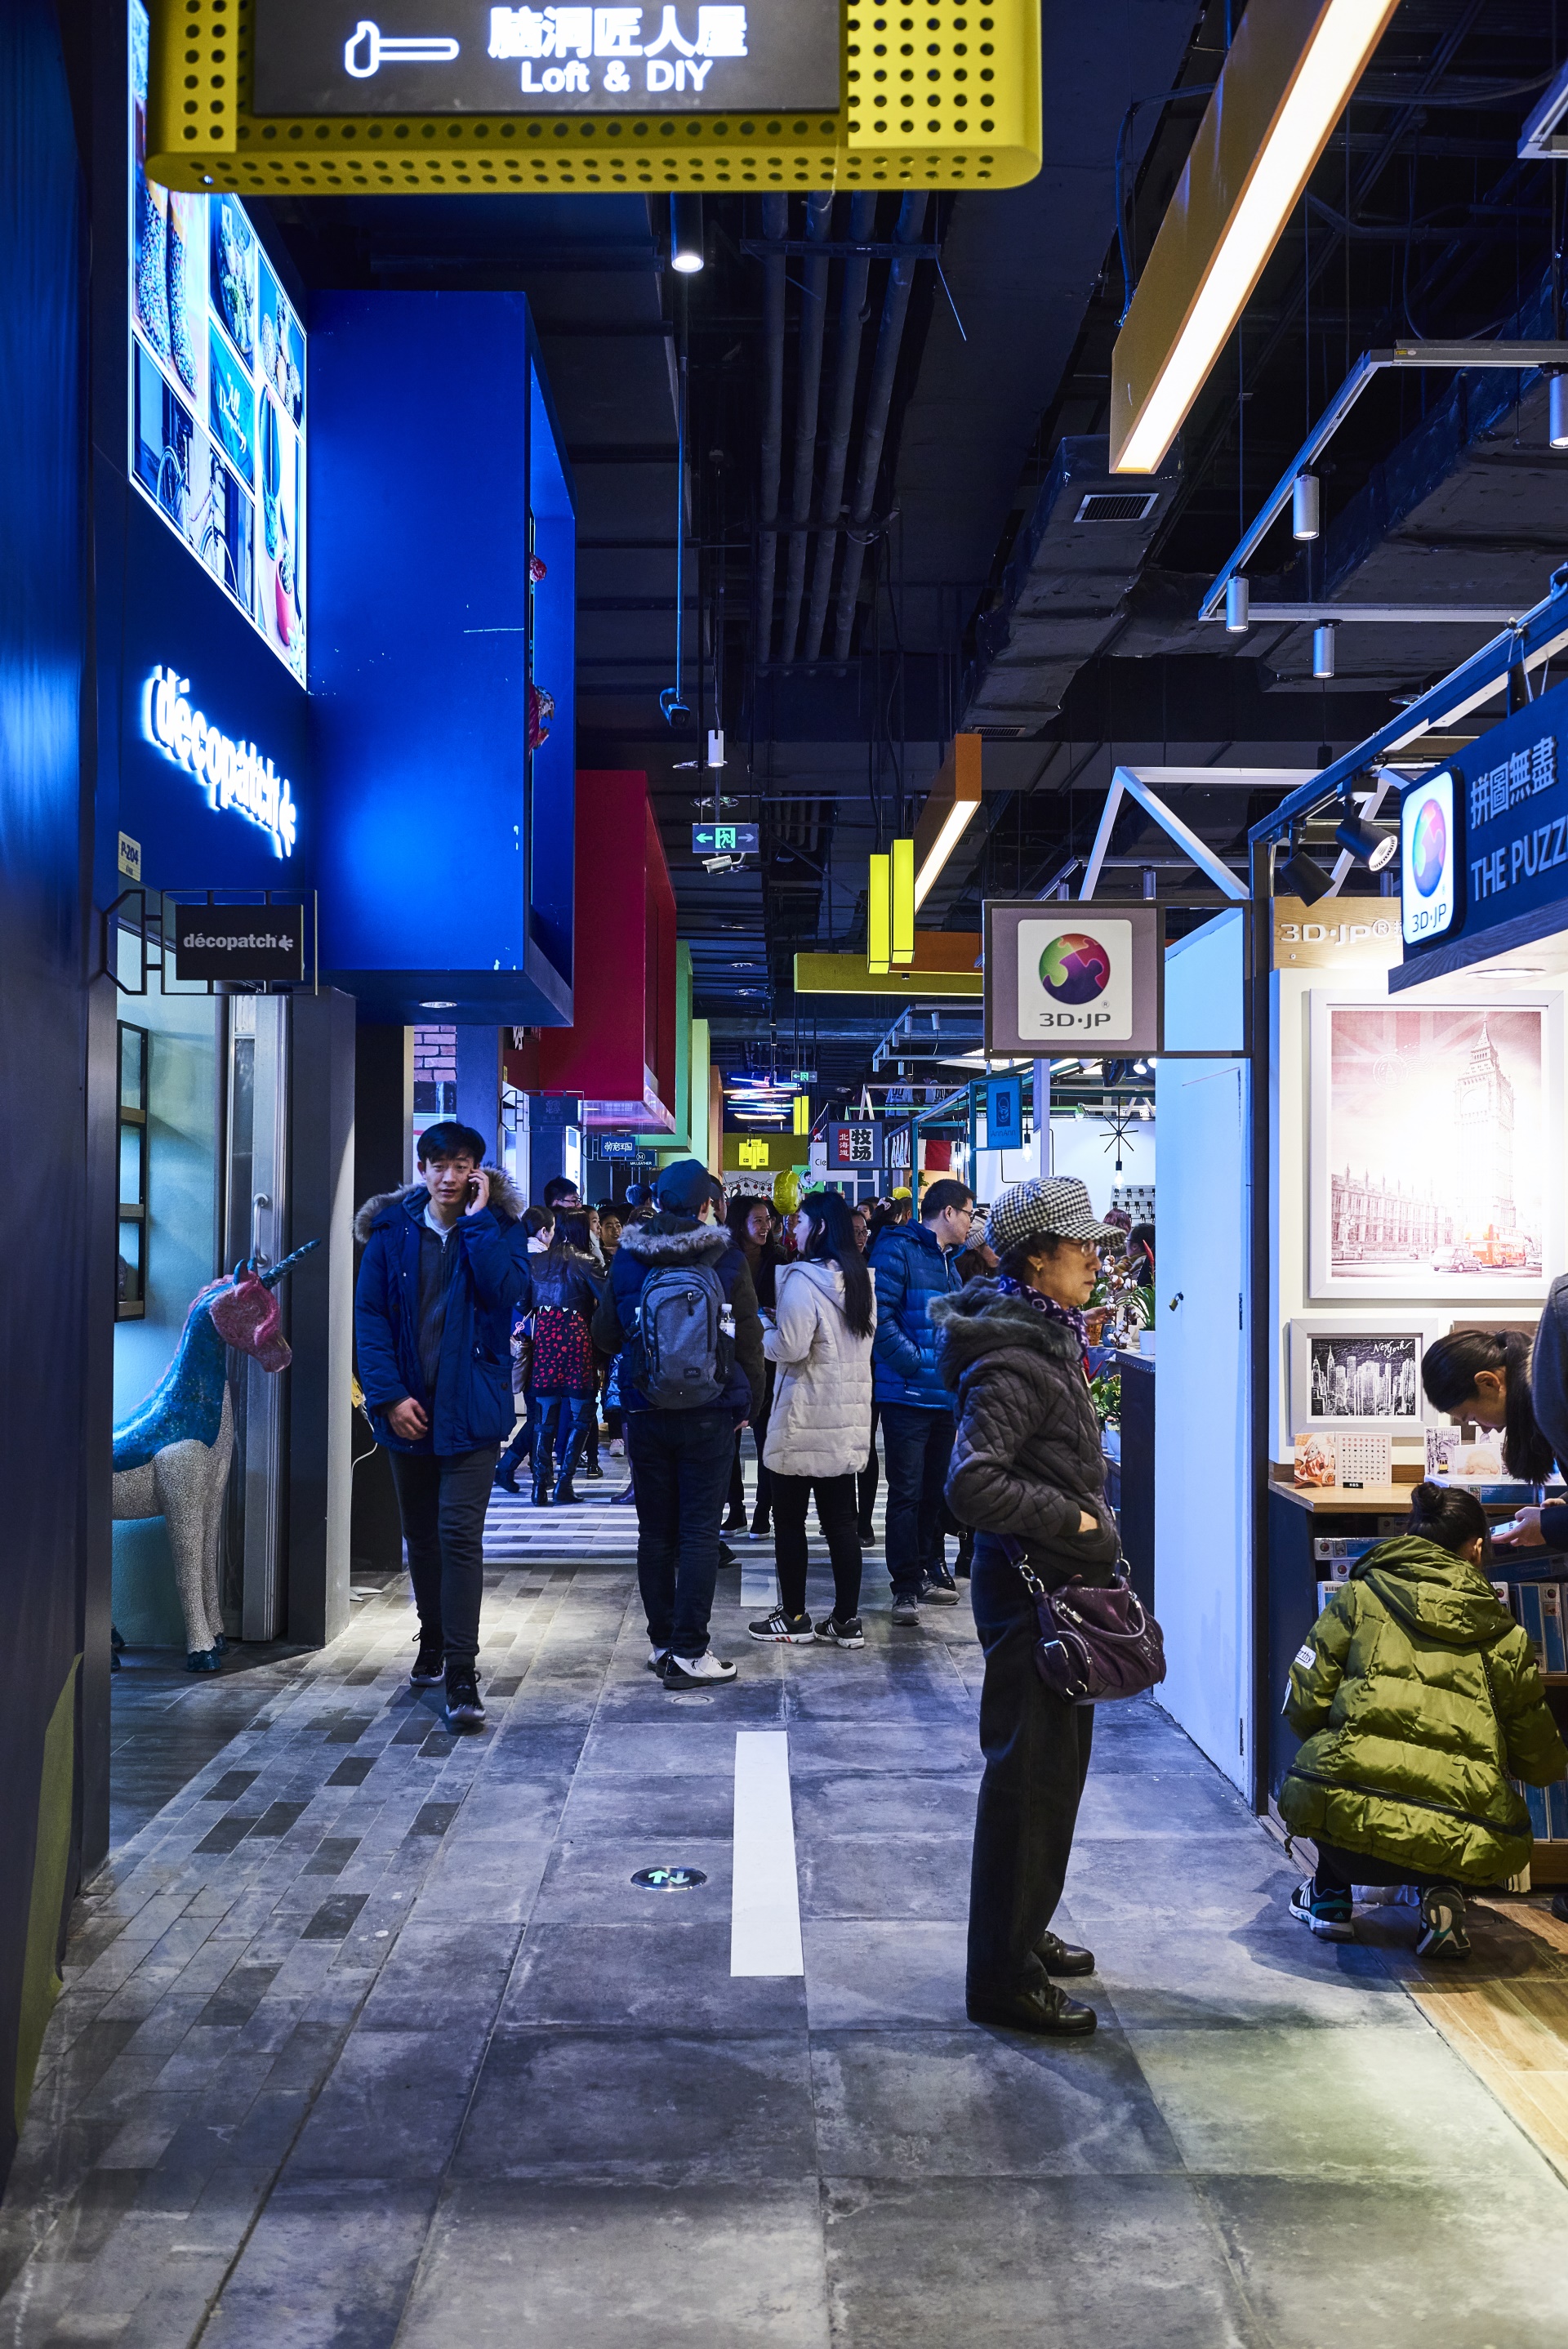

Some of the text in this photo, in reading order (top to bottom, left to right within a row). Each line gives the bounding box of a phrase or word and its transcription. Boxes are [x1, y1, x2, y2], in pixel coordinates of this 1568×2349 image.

[521, 60, 713, 92] Loft & DIY
[1471, 736, 1557, 830] 拼圖無盡
[121, 840, 139, 866] P-204
[1471, 814, 1568, 902] THE PUZZ
[183, 933, 277, 951] décopatch
[839, 1133, 849, 1157] 北海道
[851, 1128, 872, 1161] 牧场
[991, 1129, 1016, 1137] AnnAnn
[1371, 1340, 1394, 1355] New
[1384, 1339, 1413, 1358] York
